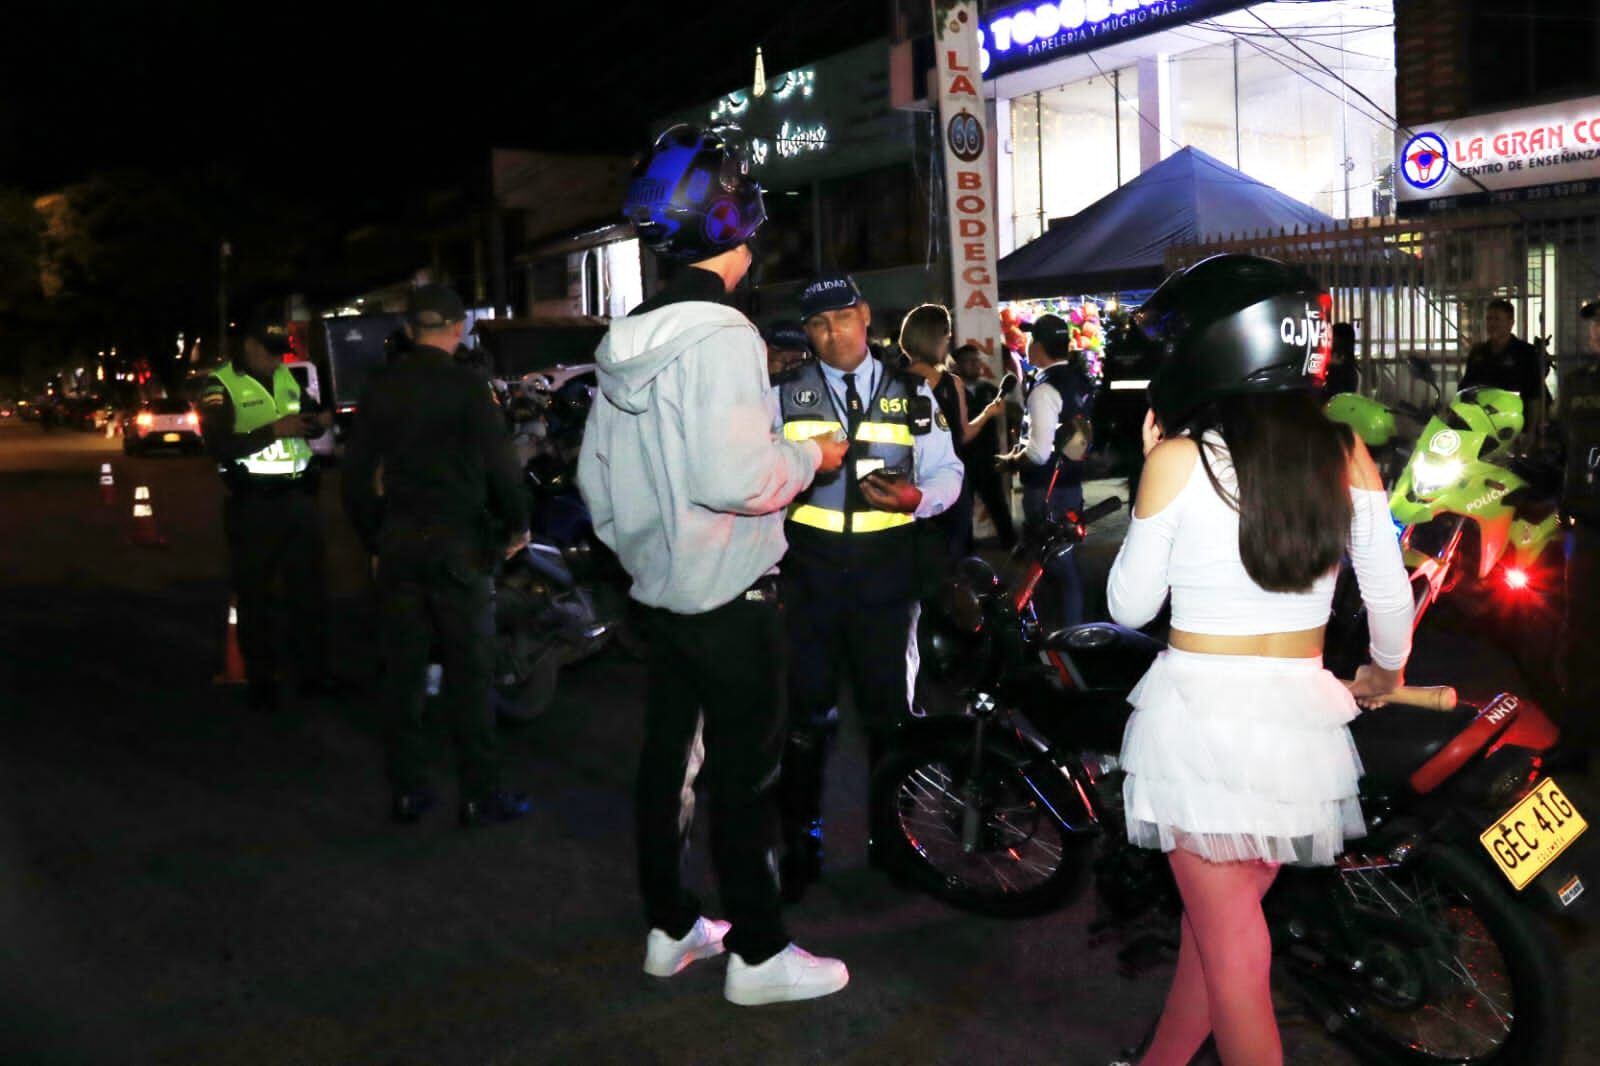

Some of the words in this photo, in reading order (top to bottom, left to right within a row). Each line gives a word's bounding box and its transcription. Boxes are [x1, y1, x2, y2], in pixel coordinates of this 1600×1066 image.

[1090, 25, 1098, 38] Y
[1101, 10, 1147, 33] MUCHO
[1455, 137, 1483, 163] LA
[1493, 125, 1564, 157] GRAN
[1460, 161, 1503, 177] CENTRO
[1508, 159, 1523, 172] DE
[956, 170, 993, 310] BODEGA
[1486, 695, 1519, 725] NKD
[1493, 821, 1539, 869] GEC
[1532, 790, 1573, 834] 41G
